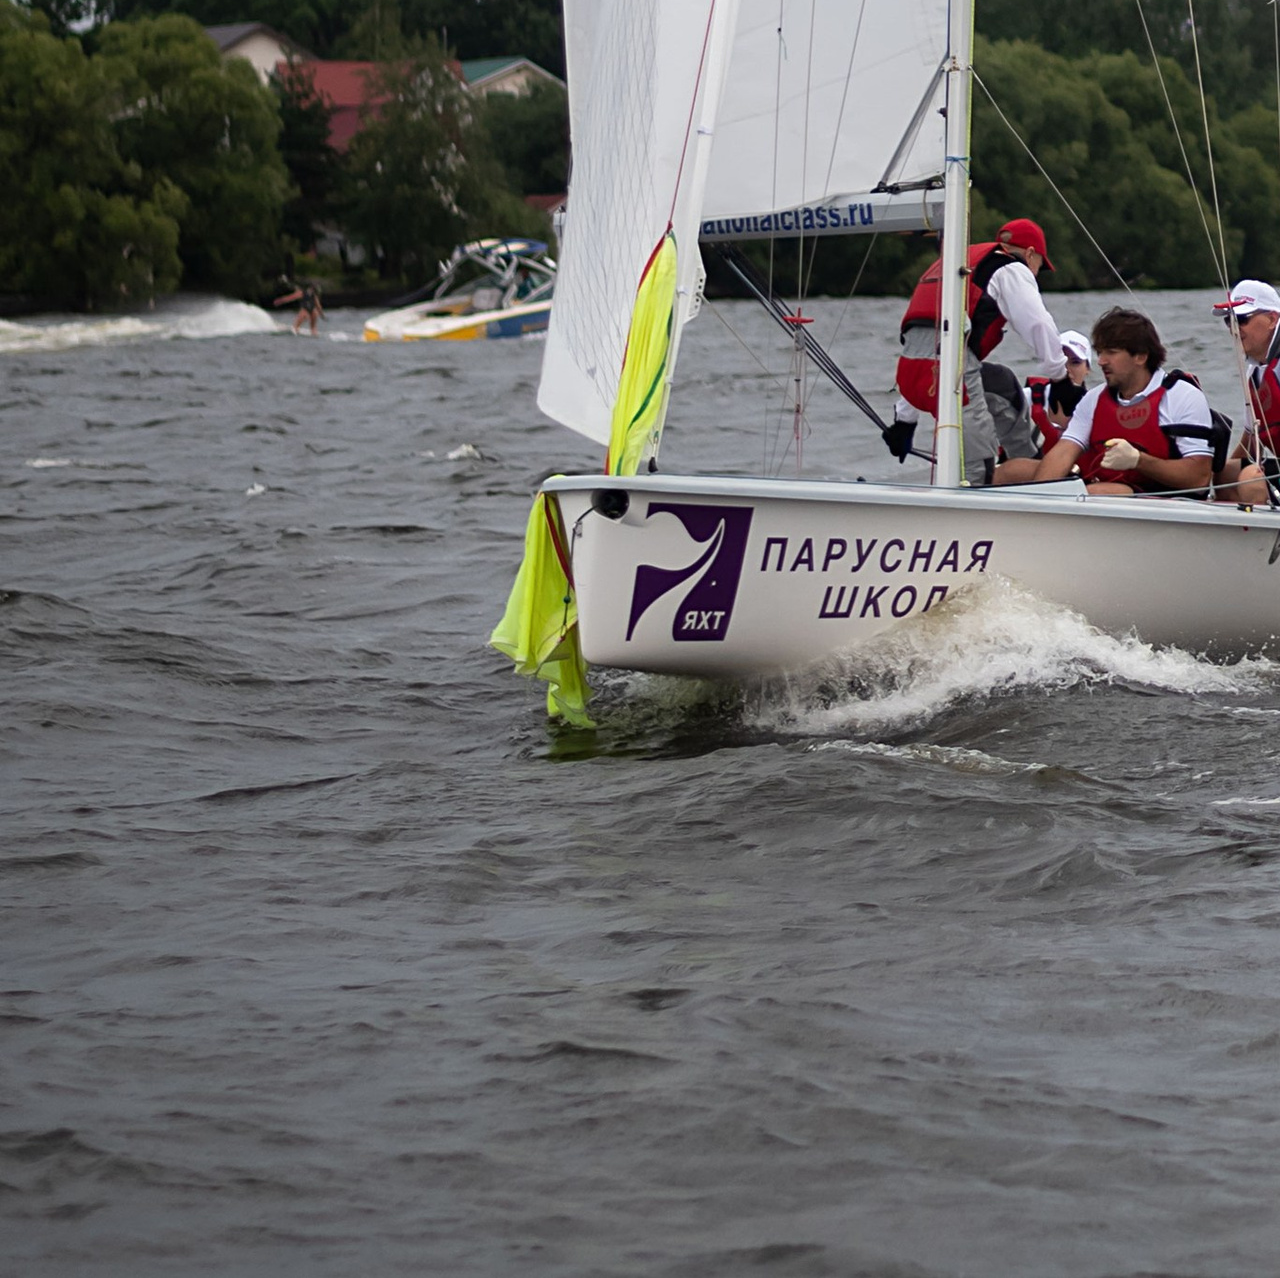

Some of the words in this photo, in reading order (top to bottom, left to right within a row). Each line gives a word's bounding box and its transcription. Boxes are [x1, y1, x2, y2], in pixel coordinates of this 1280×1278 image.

[699, 202, 874, 236] ationalclass.ru
[760, 537, 994, 573] ПАРУСНАЯ
[818, 585, 949, 619] ШКОЛ
[681, 610, 726, 630] ЯХТ
